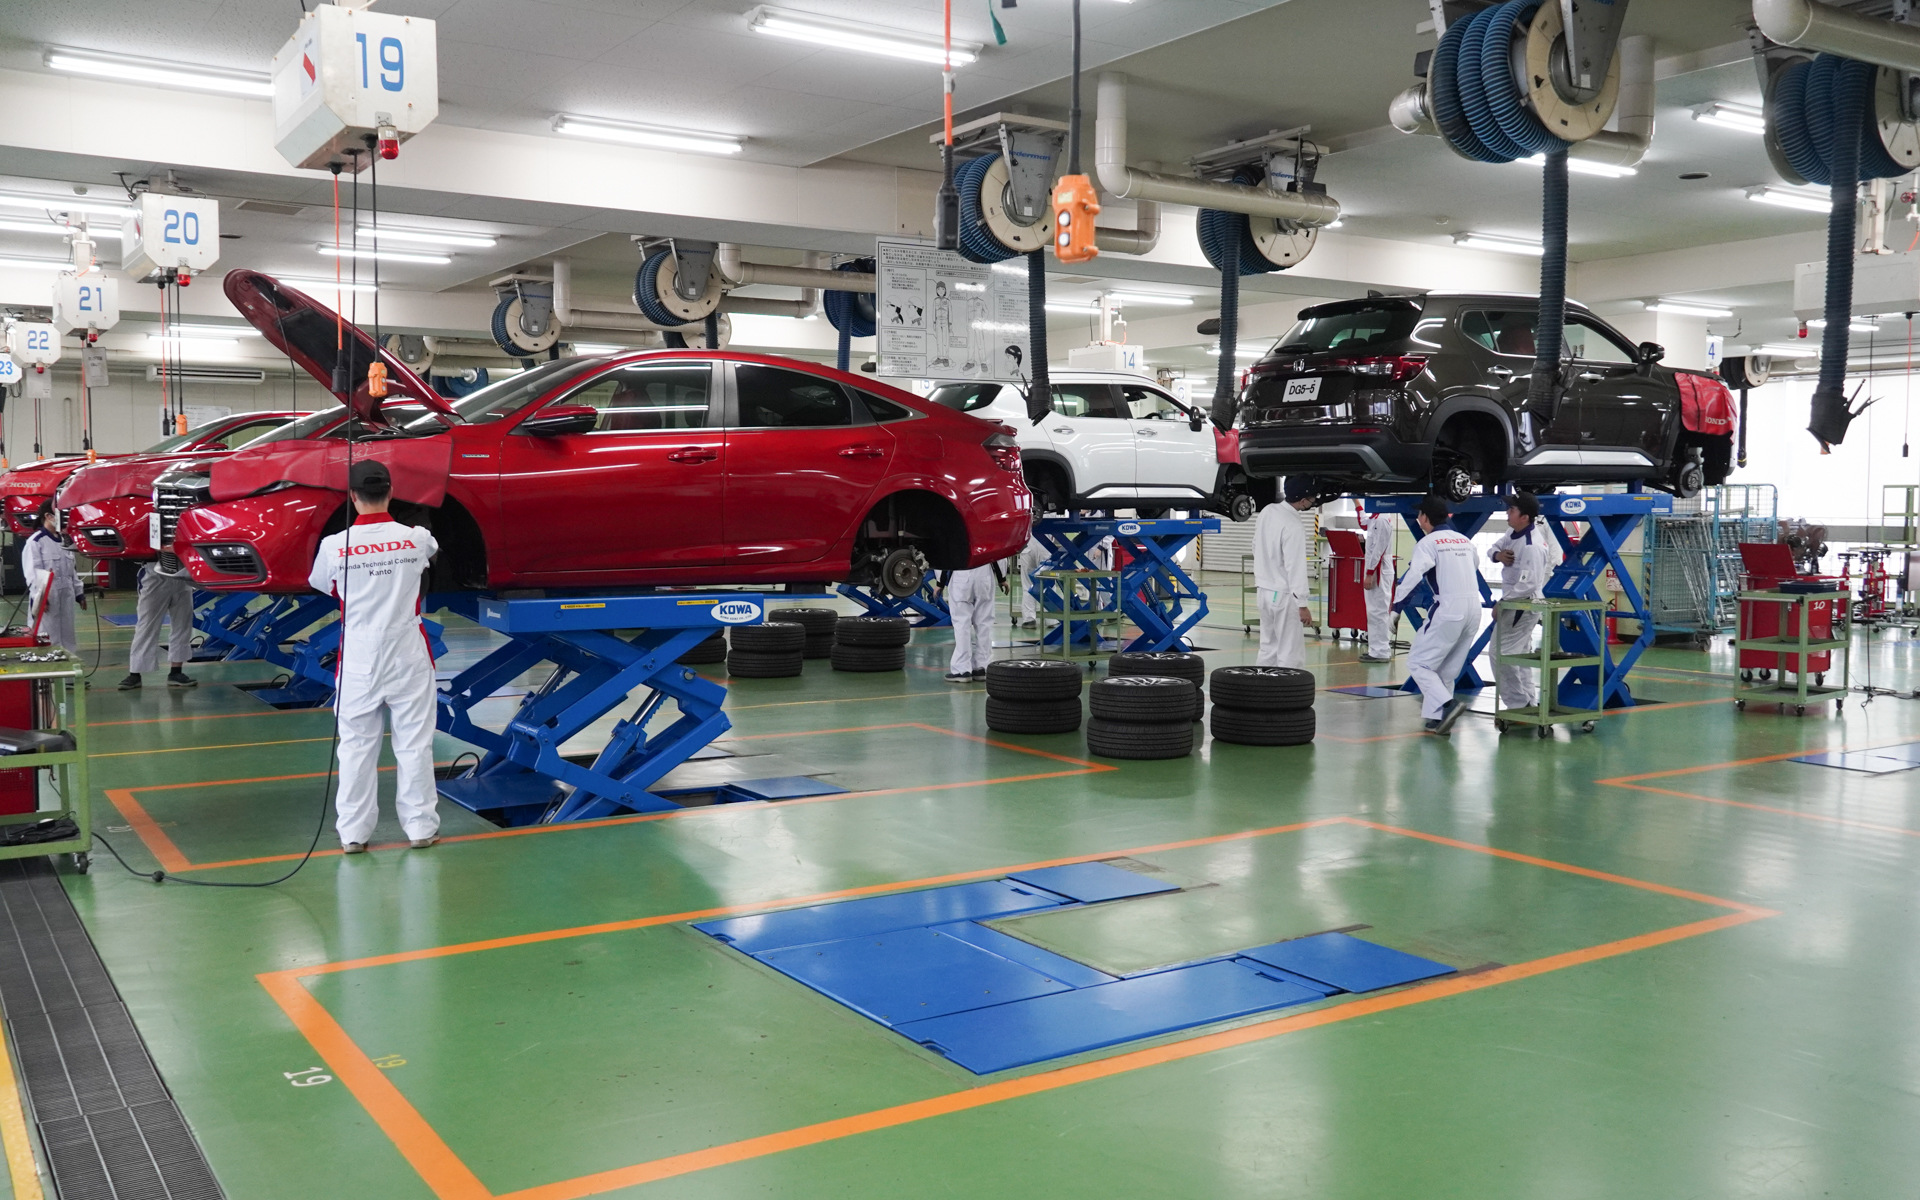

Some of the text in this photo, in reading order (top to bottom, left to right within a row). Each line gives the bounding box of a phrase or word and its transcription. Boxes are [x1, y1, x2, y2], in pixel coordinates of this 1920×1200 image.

[356, 33, 404, 92] 19
[164, 209, 199, 246] 20
[79, 286, 103, 312] 21
[27, 330, 49, 350] 22
[1708, 342, 1715, 360] 4
[0, 361, 13, 375] 23
[1123, 351, 1135, 370] 14
[1289, 383, 1316, 395] DG5-5
[338, 540, 417, 557] HONDA
[362, 560, 393, 568] Technical
[369, 569, 392, 577] Kanto
[720, 605, 752, 615] KOWA
[1813, 601, 1825, 610] 10
[371, 1054, 407, 1069] 19
[283, 1067, 332, 1087] 19
